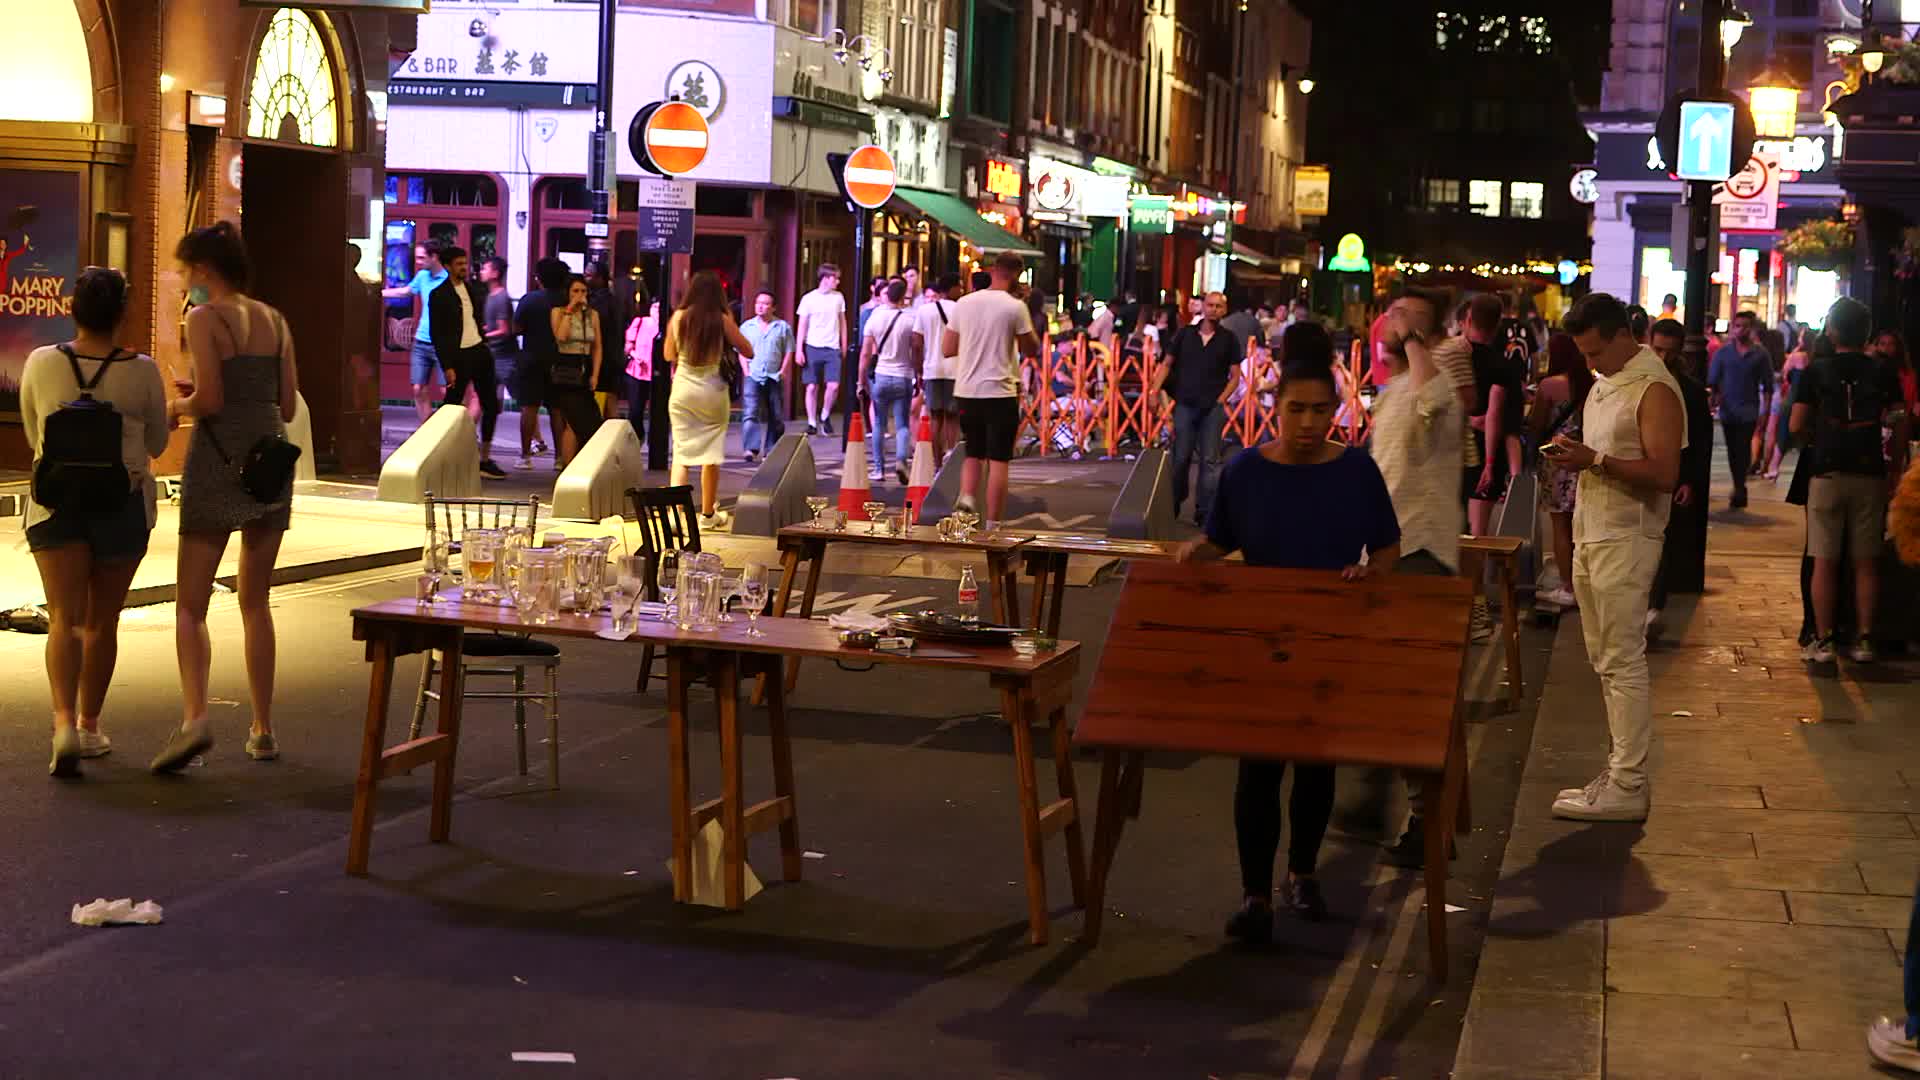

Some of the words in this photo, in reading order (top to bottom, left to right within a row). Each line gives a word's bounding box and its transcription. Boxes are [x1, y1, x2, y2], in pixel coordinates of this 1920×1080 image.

[408, 57, 418, 73] &
[424, 57, 458, 73] BAR
[464, 87, 486, 96] BAR
[10, 275, 65, 297] MARY
